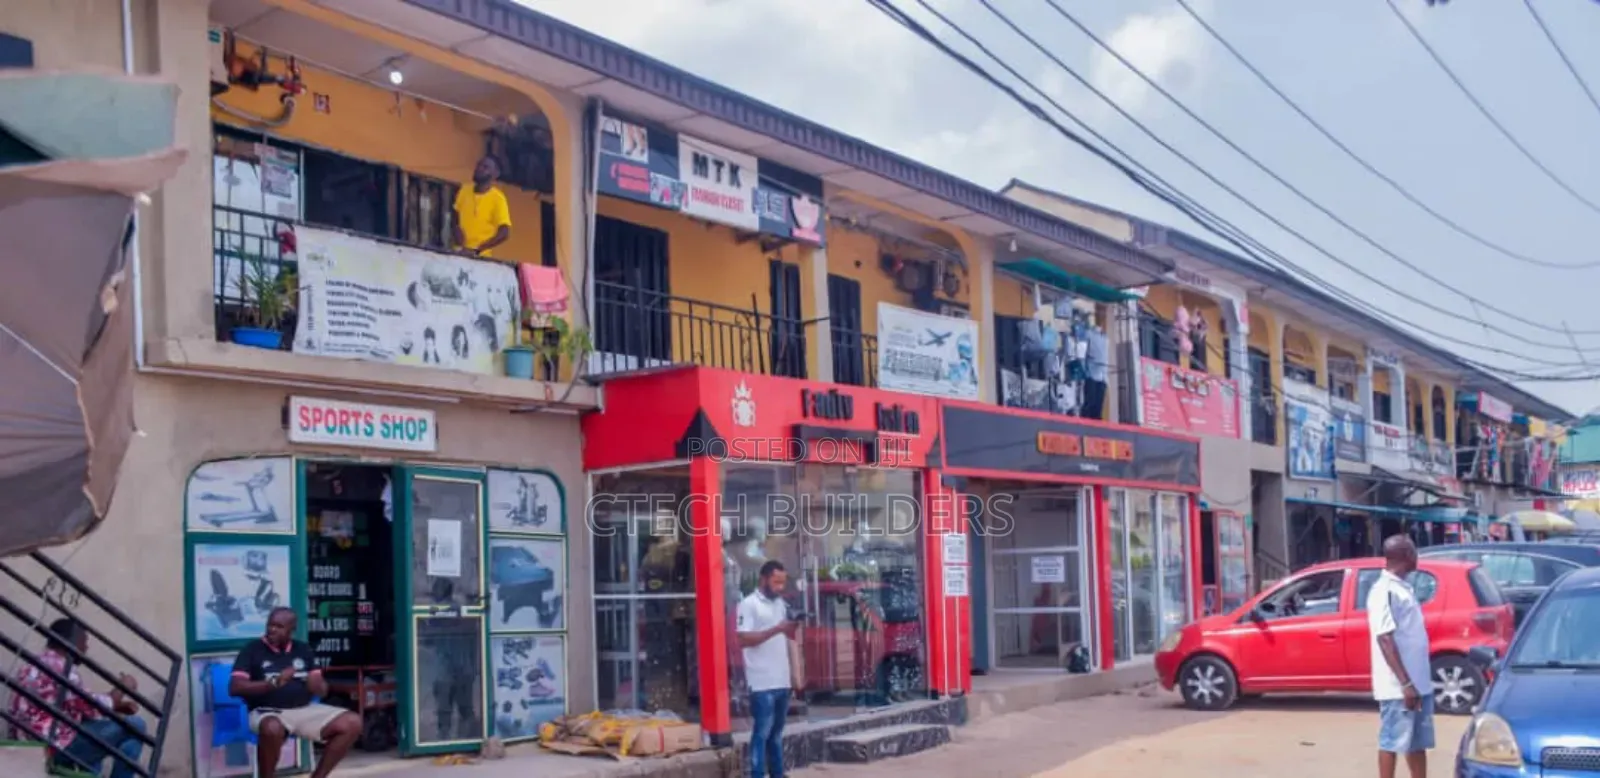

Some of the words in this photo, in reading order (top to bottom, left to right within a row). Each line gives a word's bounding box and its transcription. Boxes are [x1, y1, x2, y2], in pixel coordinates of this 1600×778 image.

[692, 152, 742, 189] MTK
[299, 404, 375, 437] SPORTS
[379, 413, 428, 441] SHOP
